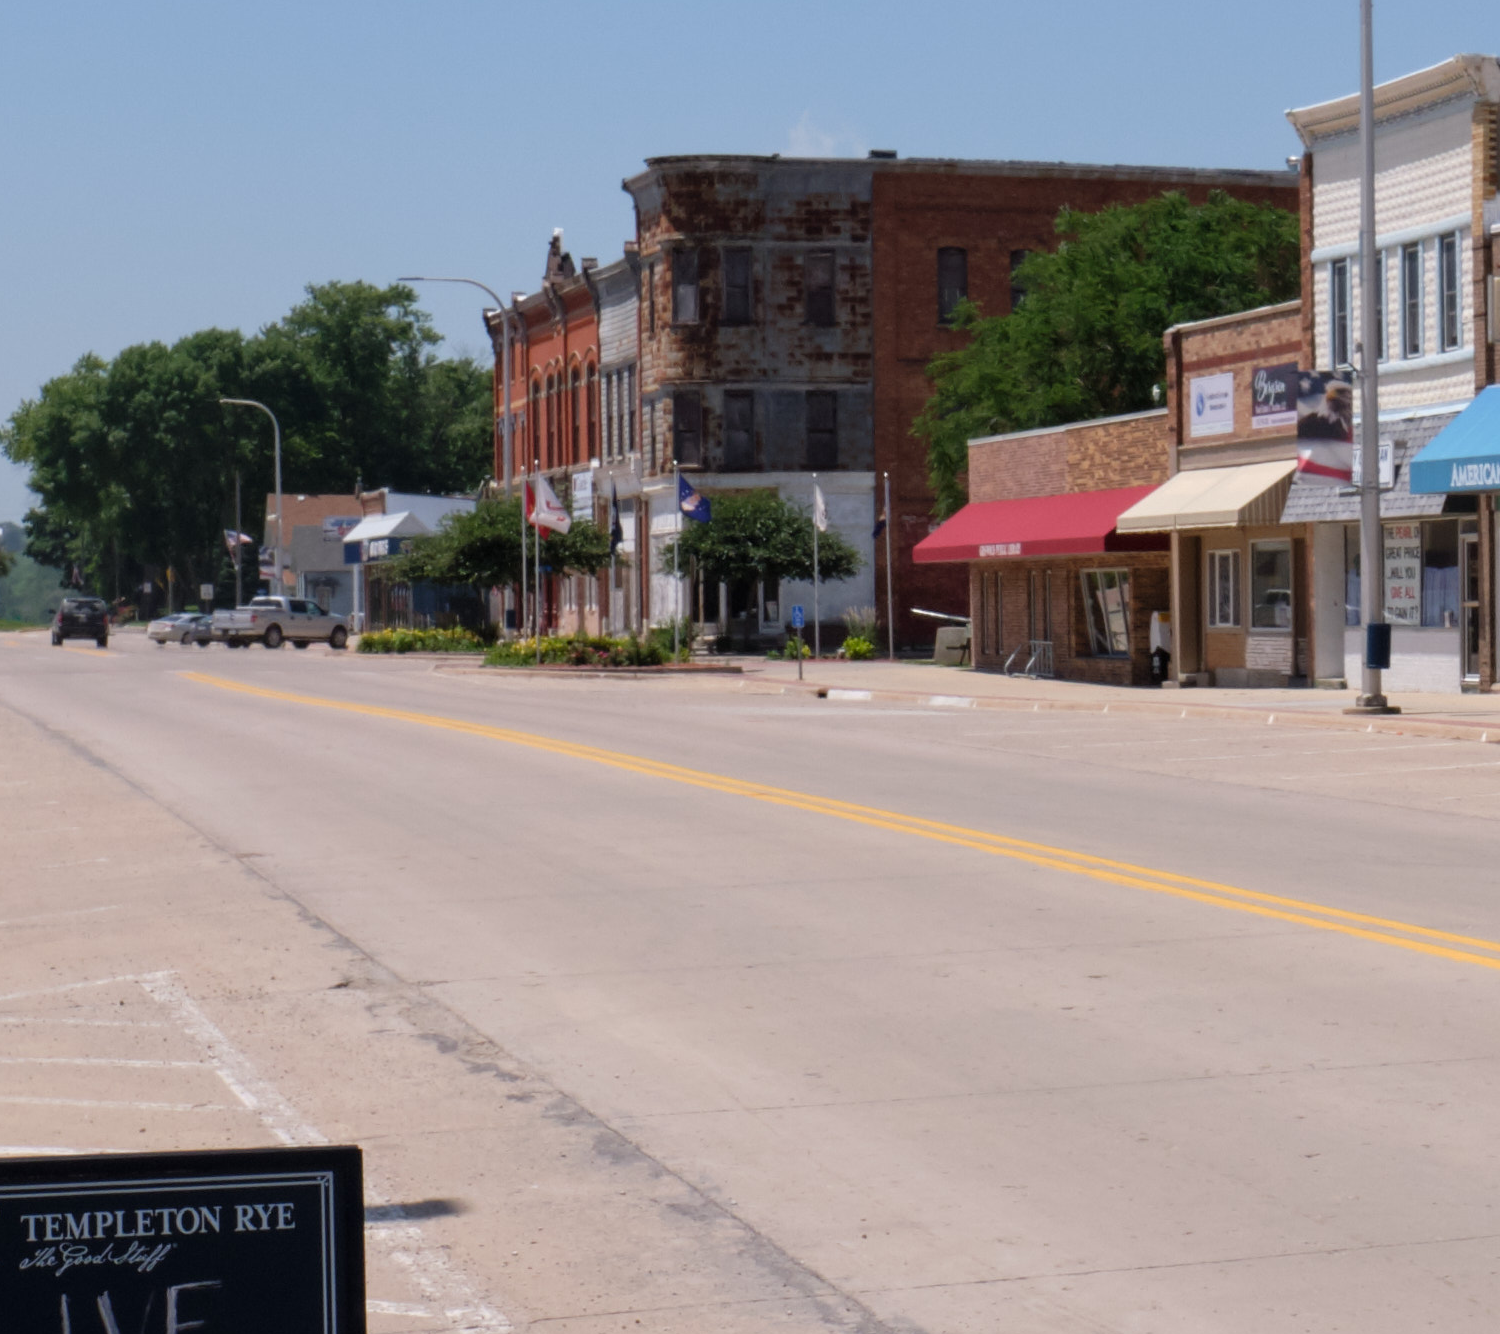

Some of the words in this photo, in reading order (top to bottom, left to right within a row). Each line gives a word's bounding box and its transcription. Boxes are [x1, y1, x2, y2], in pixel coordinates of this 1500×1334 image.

[20, 1205, 222, 1243] TEMPLETON
[234, 1202, 296, 1232] RYE
[18, 1247, 56, 1270] The
[55, 1242, 108, 1277] Good
